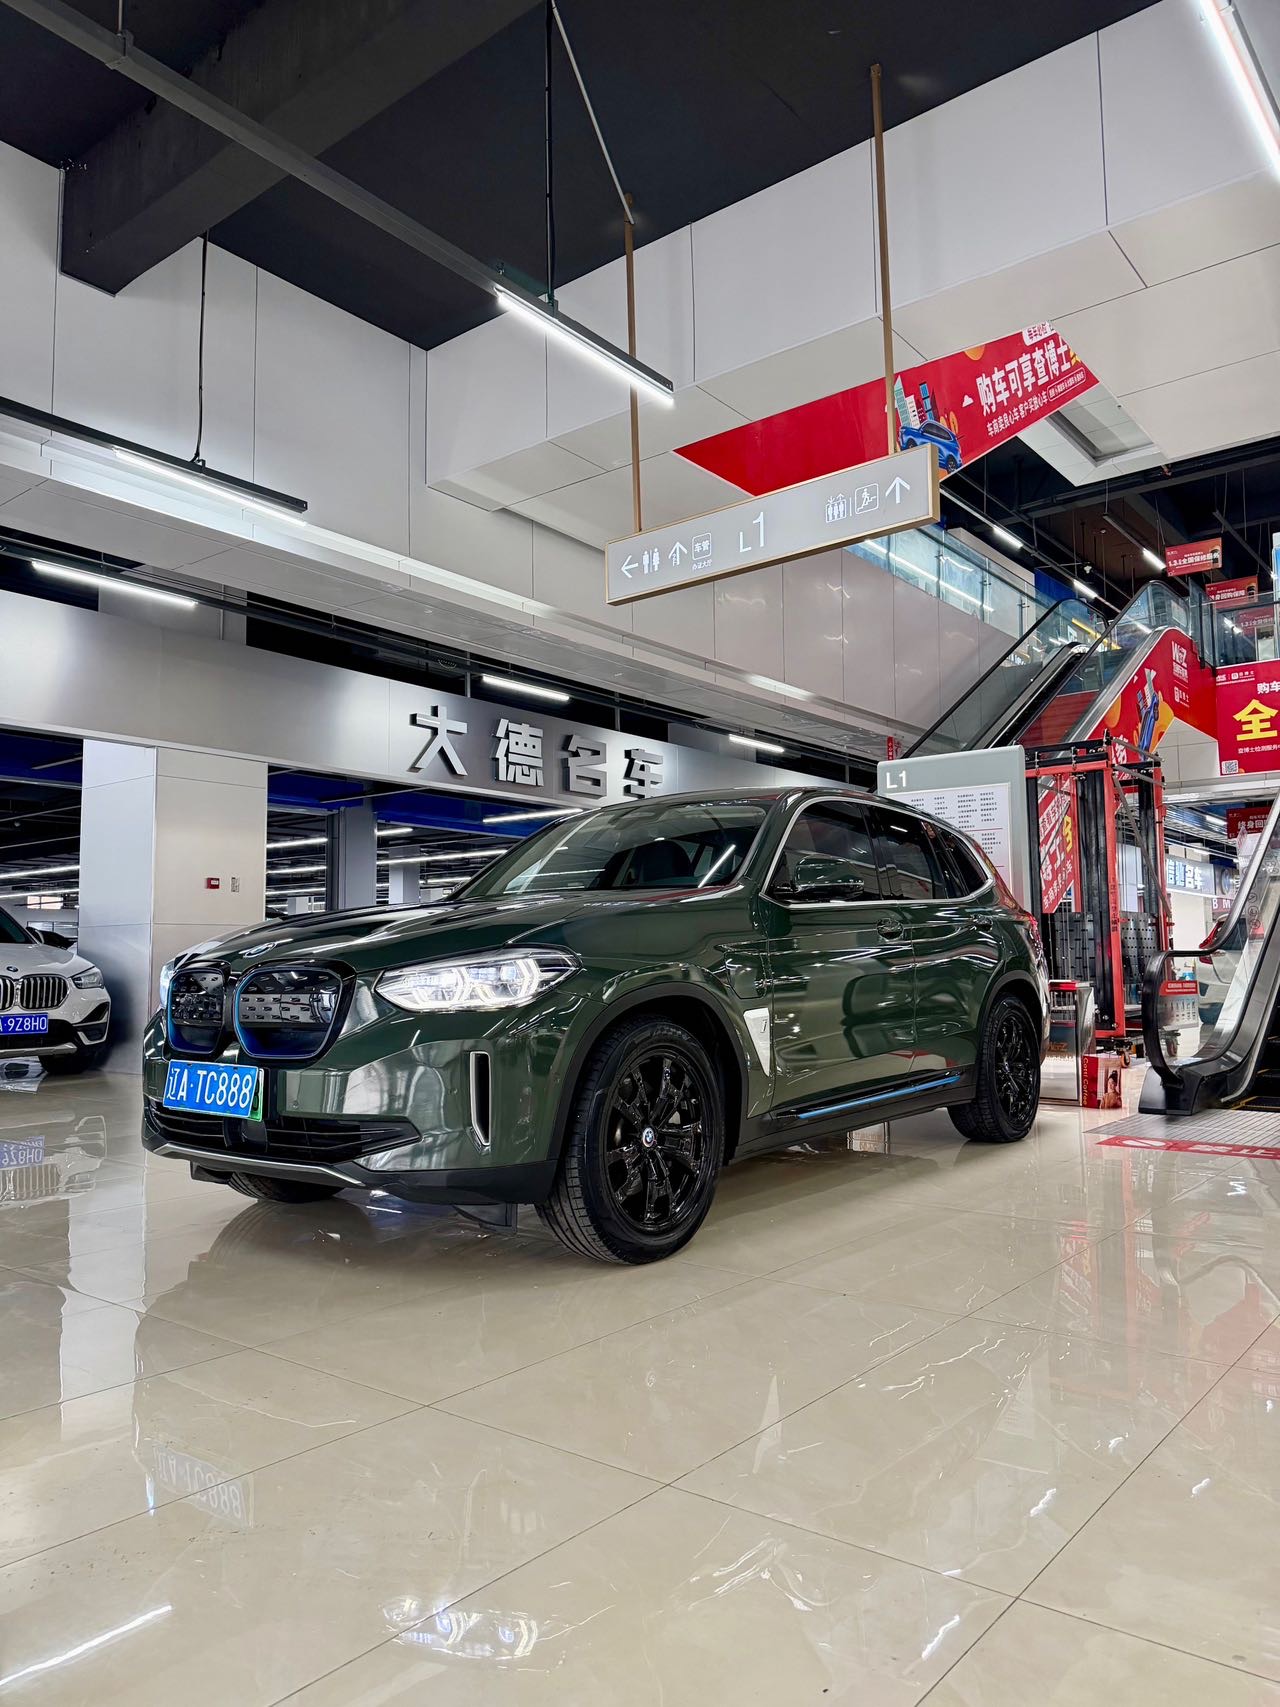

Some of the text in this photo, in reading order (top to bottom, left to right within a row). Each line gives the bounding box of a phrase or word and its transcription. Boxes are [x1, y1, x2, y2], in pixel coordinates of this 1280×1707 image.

[976, 335, 1081, 417] 购车可享查博士
[694, 539, 710, 553] 车管
[1256, 680, 1280, 695] 购车
[1232, 699, 1279, 742] 全
[409, 704, 664, 800] 大德名车
[886, 770, 907, 789] L1
[1237, 819, 1268, 830] 终身回
